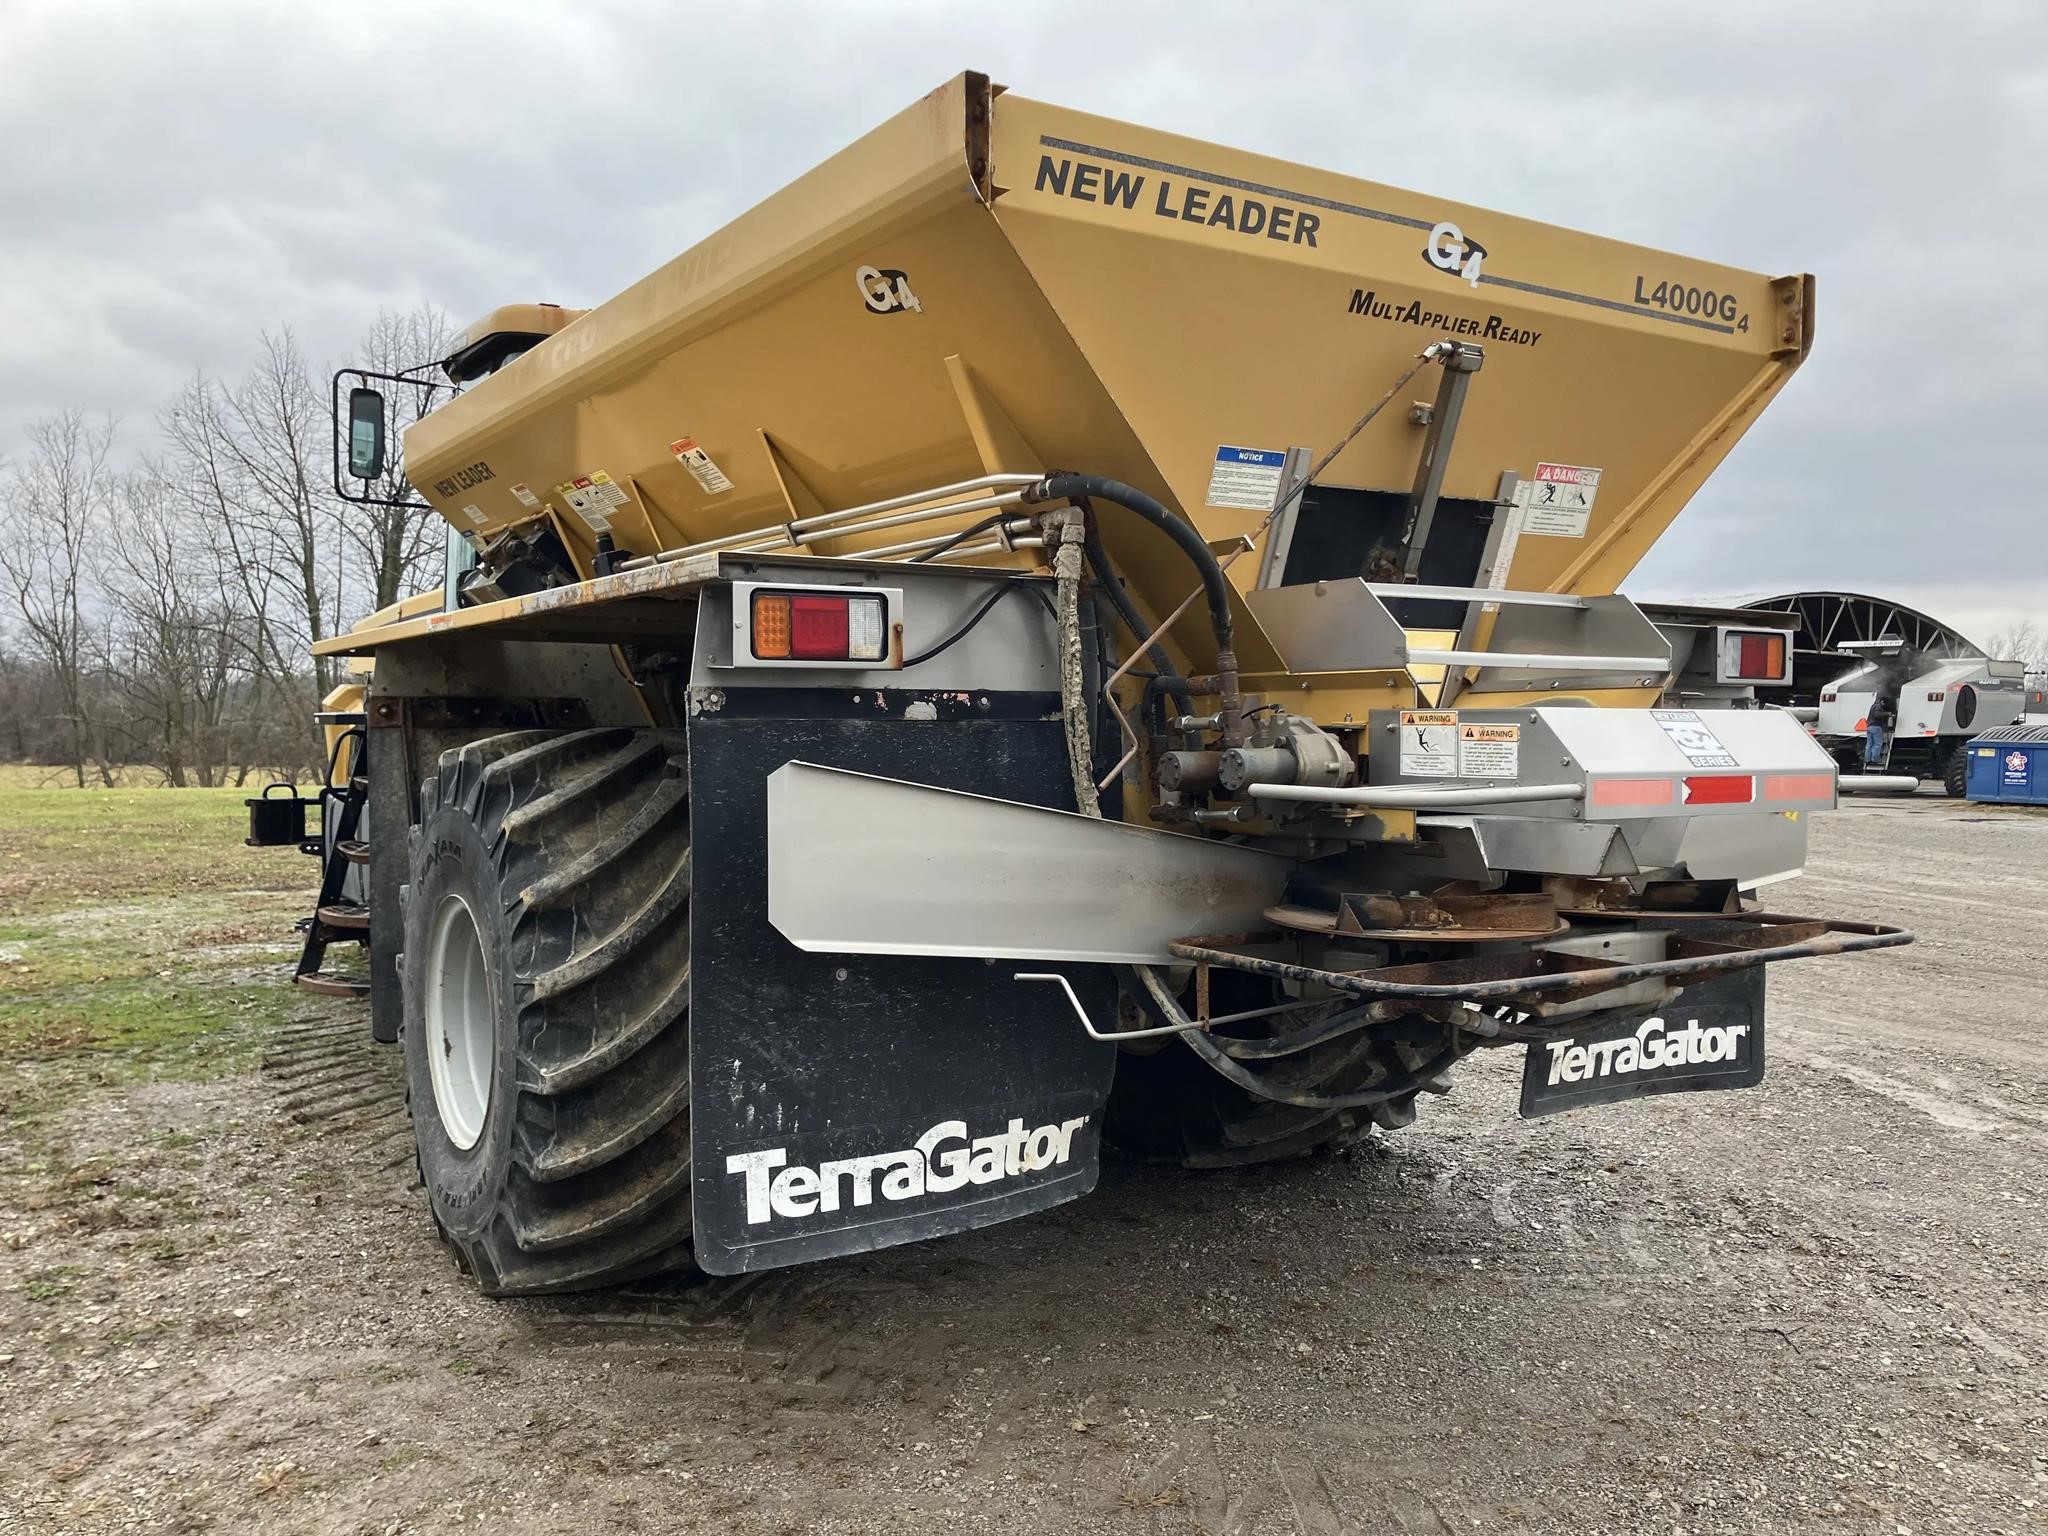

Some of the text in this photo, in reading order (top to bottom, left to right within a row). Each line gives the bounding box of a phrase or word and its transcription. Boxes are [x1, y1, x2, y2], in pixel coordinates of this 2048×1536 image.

[1034, 155, 1322, 249] NEW LEADER
[1428, 221, 1483, 288] G4
[1238, 452, 1264, 462] NOTICE
[433, 461, 497, 500] NEW LEADER
[1552, 467, 1597, 483] DANGER
[1418, 714, 1451, 723] WARNING
[1478, 728, 1514, 738] WARNING
[1690, 756, 1735, 767] SERIES
[1545, 1016, 1746, 1086] TerraGator
[725, 1115, 1085, 1226] TerraGator
